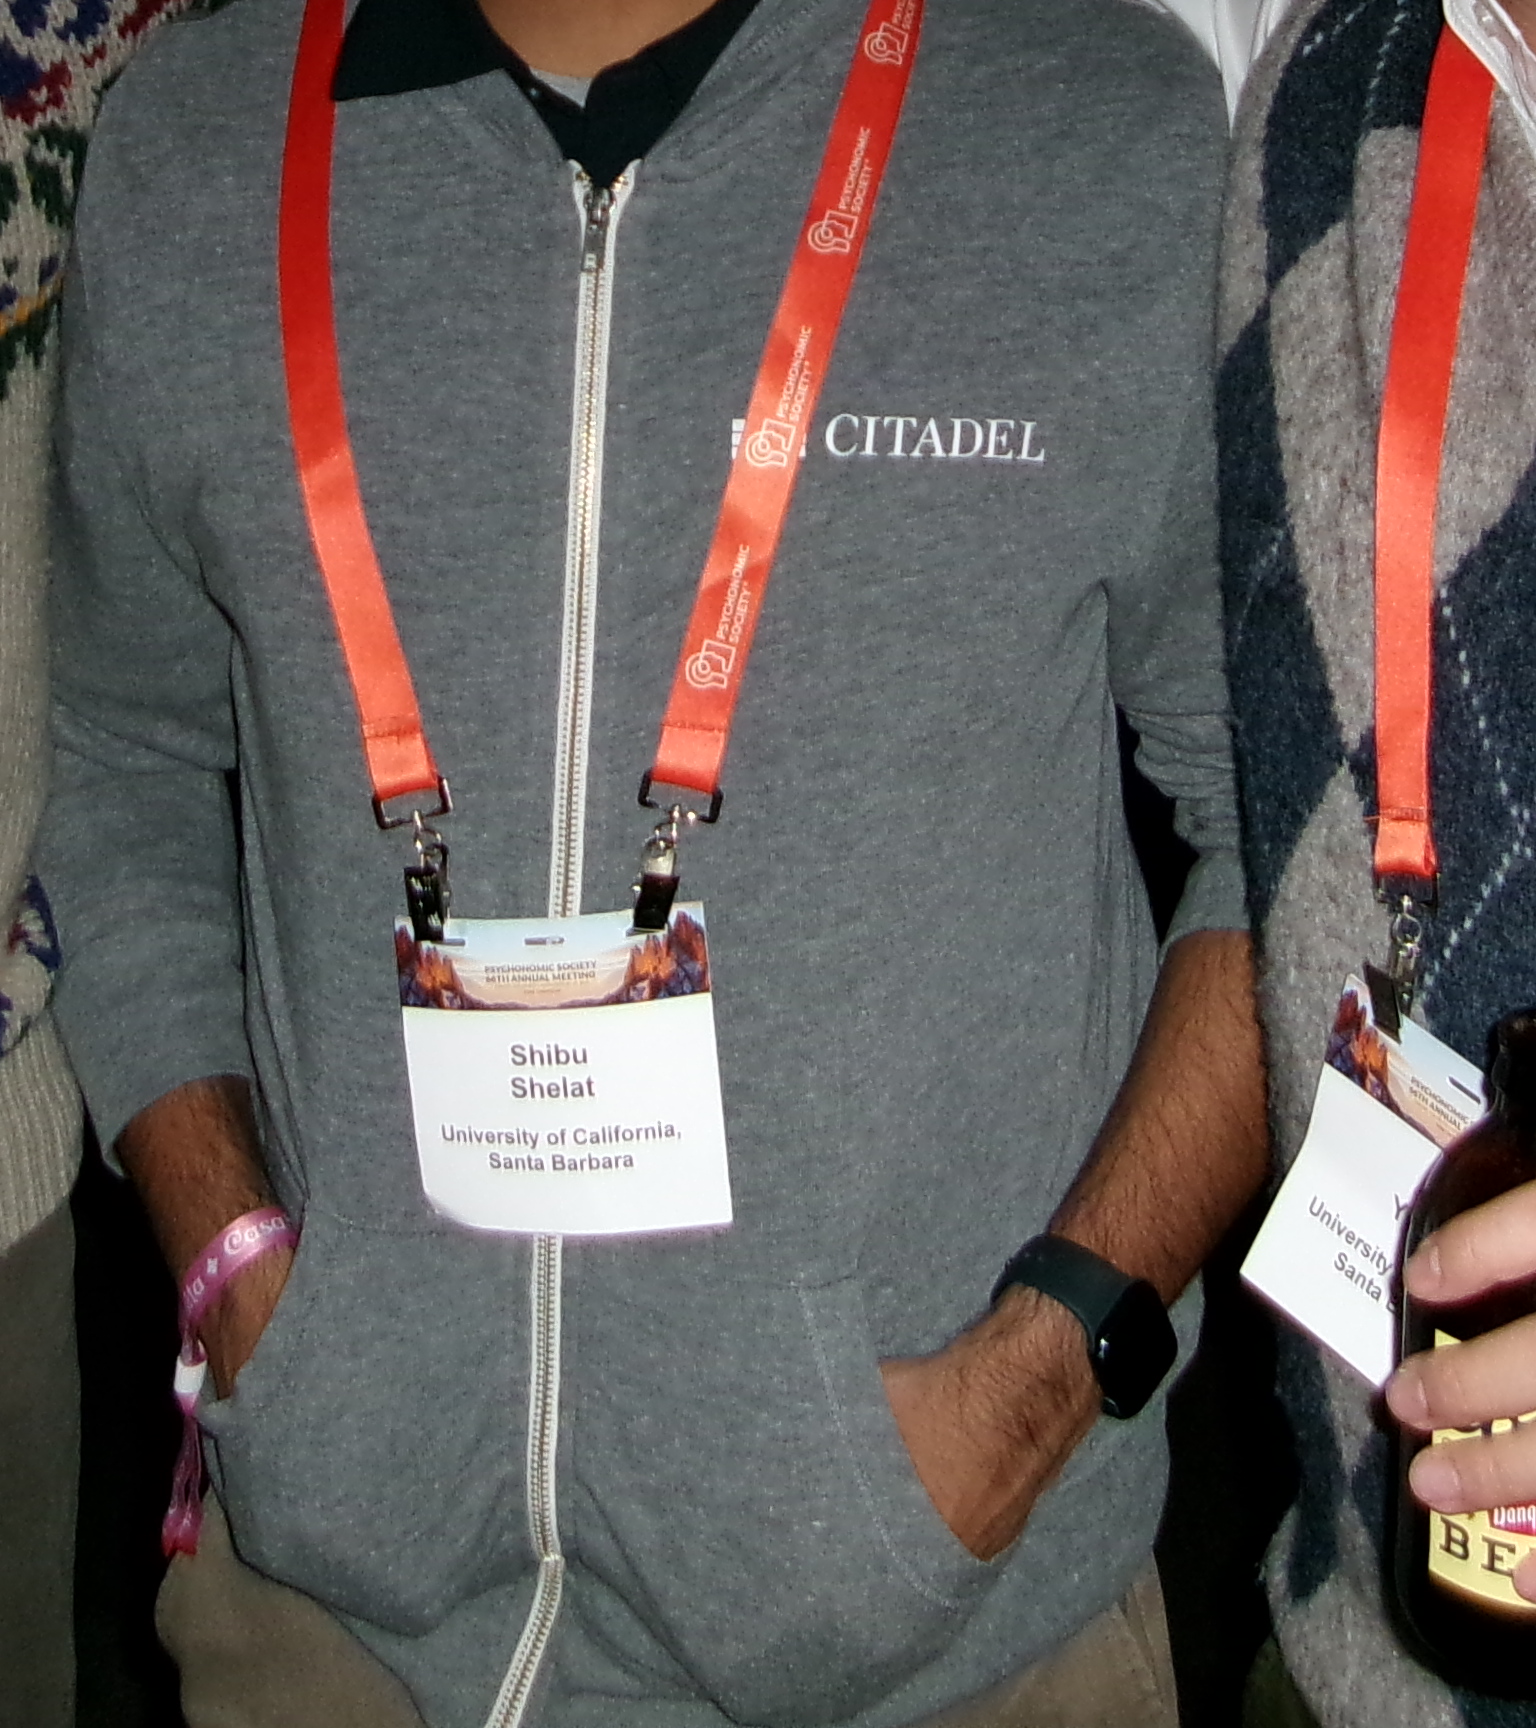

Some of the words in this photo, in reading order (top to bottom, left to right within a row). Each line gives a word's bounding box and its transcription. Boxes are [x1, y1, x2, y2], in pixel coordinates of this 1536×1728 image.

[777, 325, 813, 420] PSYCHONOMIC
[824, 413, 1047, 464] CITADEL
[716, 543, 752, 642] PSYCHONOMIC
[510, 1043, 589, 1068] Shibu
[510, 1075, 596, 1100] Shelat
[441, 1124, 540, 1149] University
[546, 1127, 567, 1146] of
[572, 1120, 683, 1145] California,
[488, 1152, 545, 1171] Santa
[551, 1152, 635, 1172] Barbara
[224, 1216, 285, 1255] Casa
[1307, 1194, 1394, 1277] University
[1333, 1250, 1383, 1302] Santa
